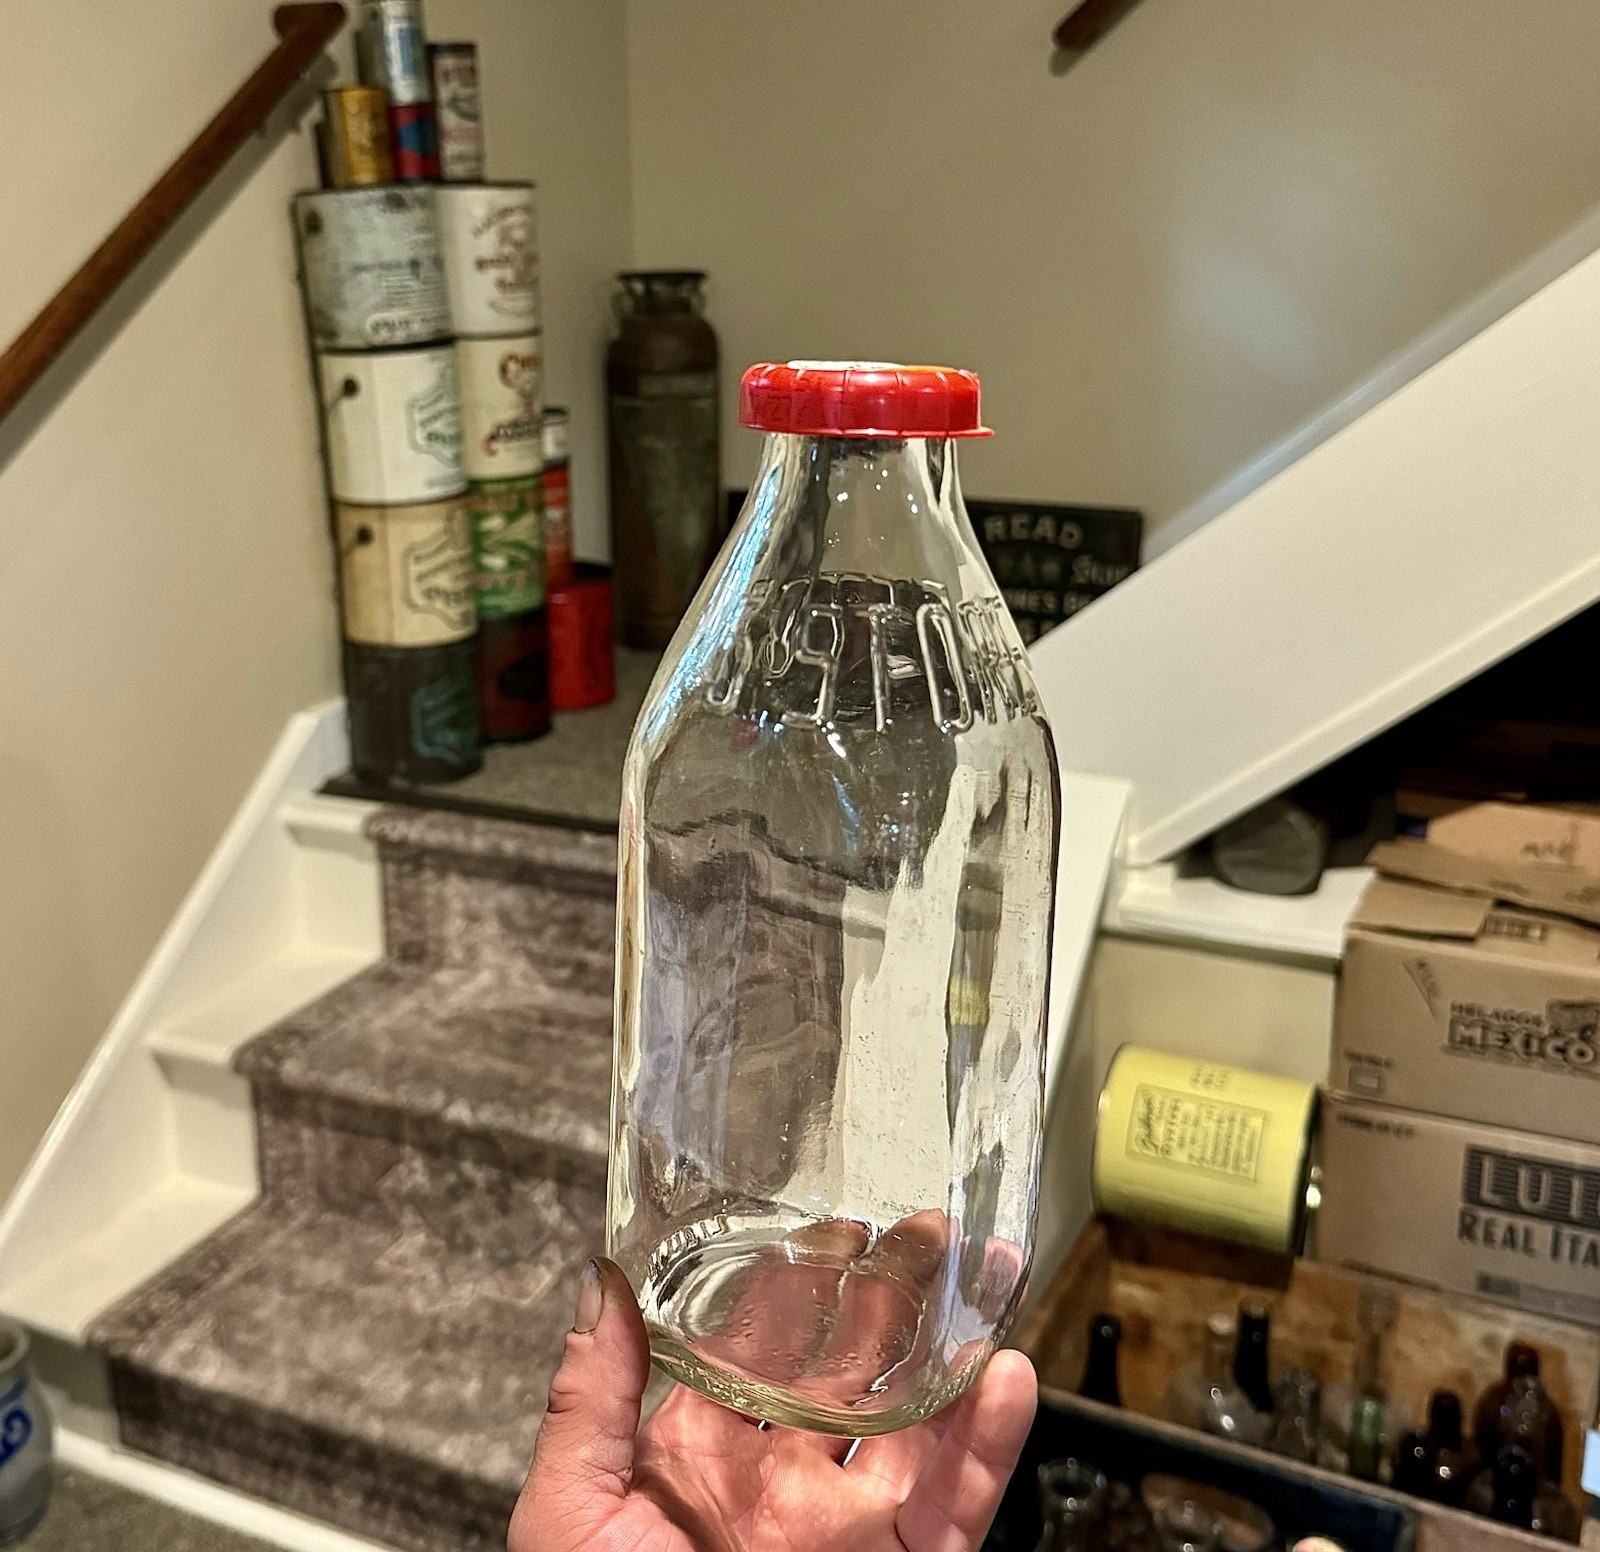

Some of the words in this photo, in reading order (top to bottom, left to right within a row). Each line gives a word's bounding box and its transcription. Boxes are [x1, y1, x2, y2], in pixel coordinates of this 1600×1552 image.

[984, 513, 1083, 549] READ
[1454, 1022, 1596, 1064] MEXICO
[1478, 1152, 1600, 1220] LUI
[1457, 1208, 1536, 1257] REAL
